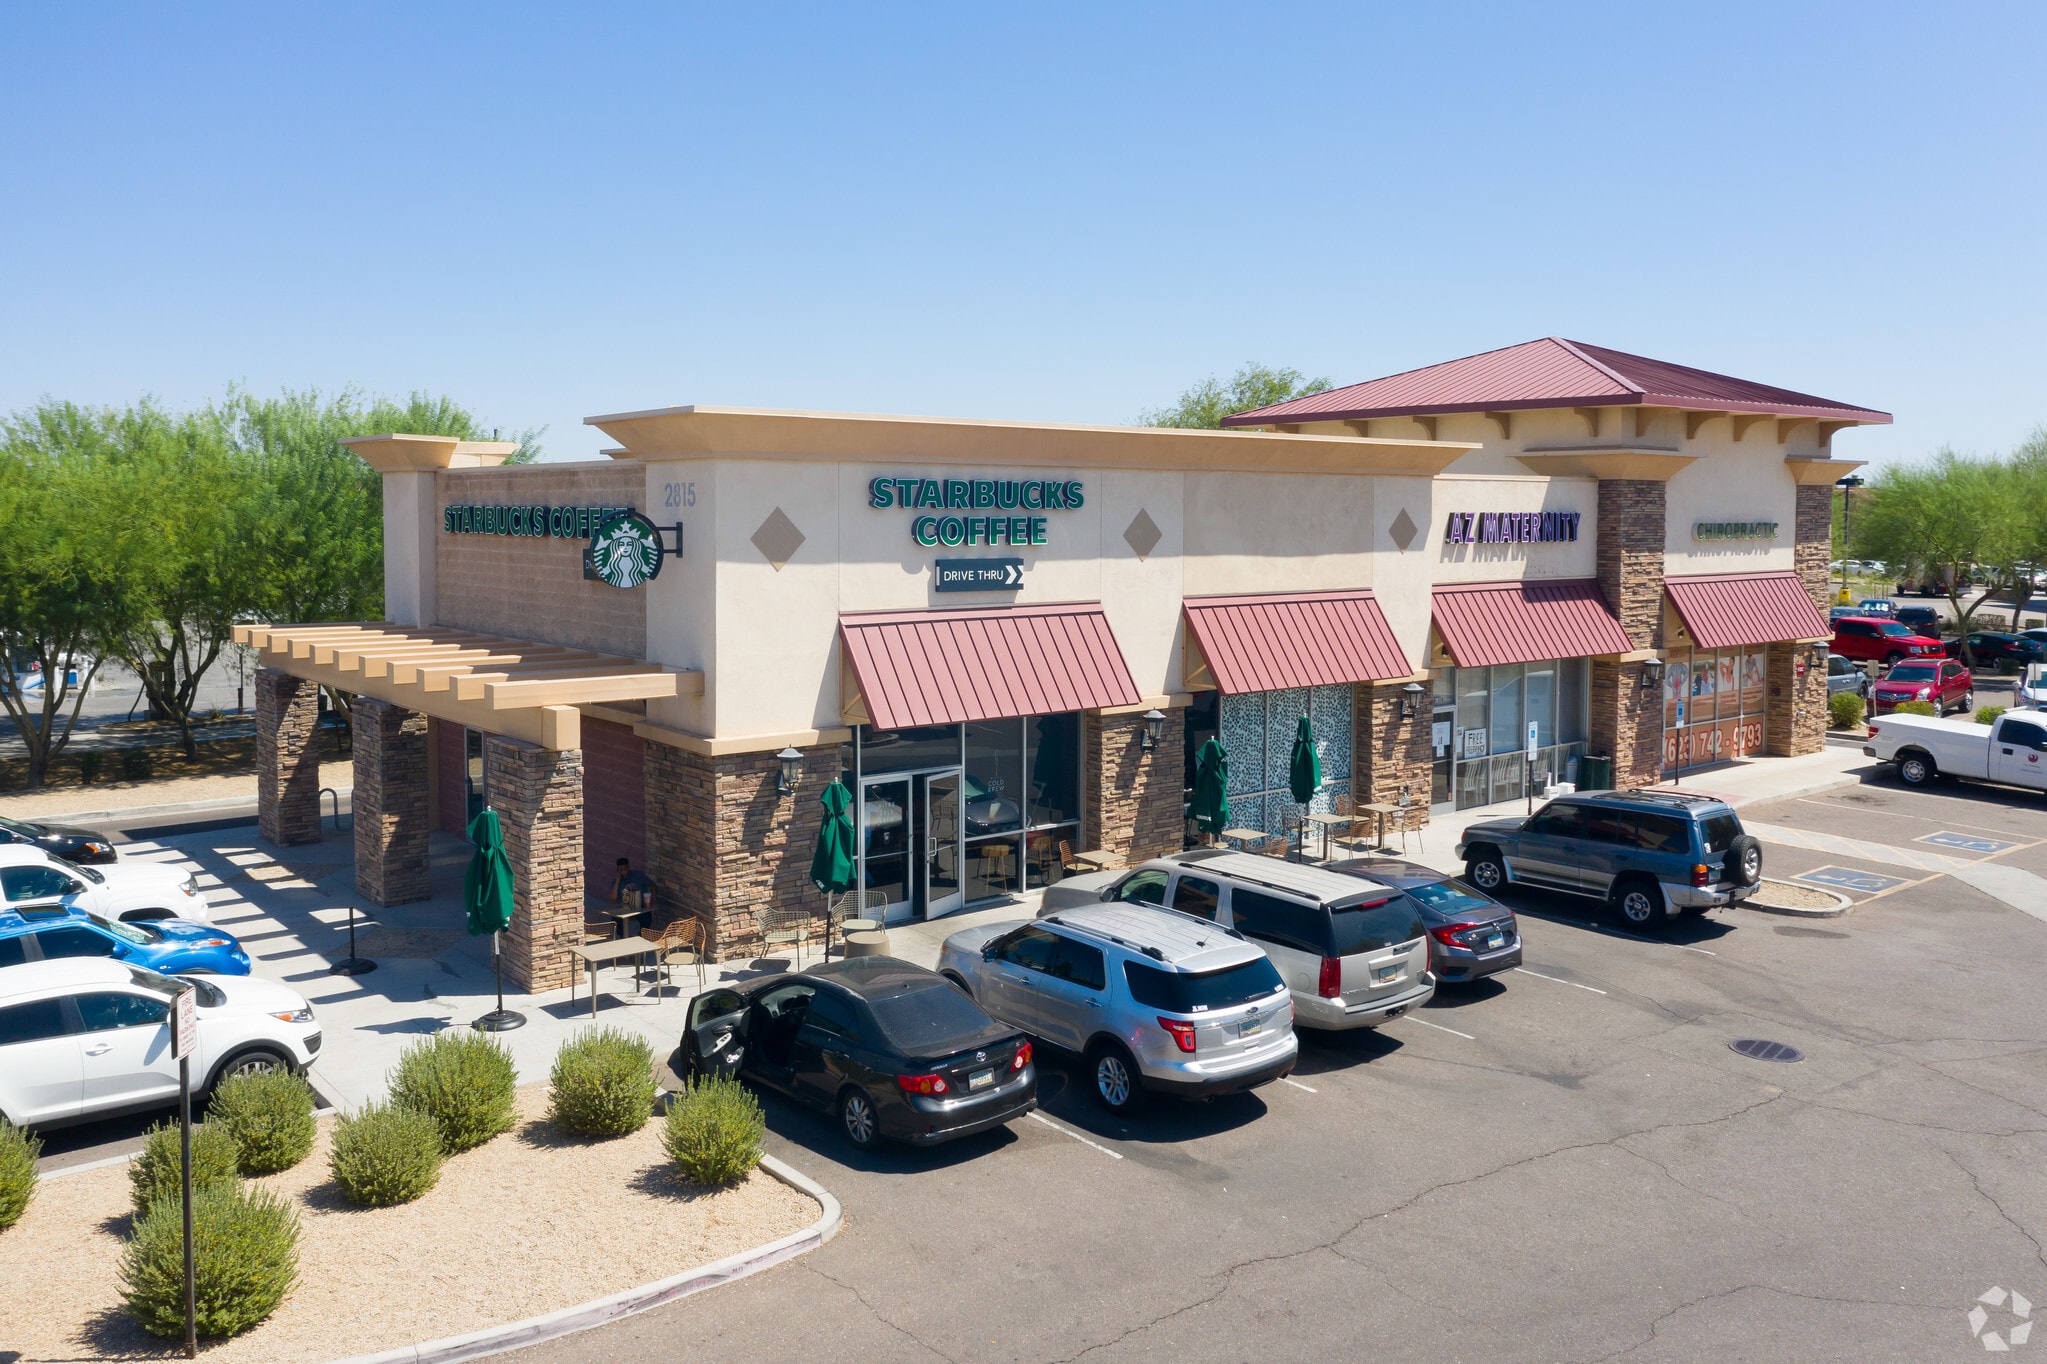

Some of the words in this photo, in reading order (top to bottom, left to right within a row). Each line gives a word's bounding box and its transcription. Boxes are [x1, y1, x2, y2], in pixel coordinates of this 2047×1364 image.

[664, 482, 696, 508] 2815
[870, 477, 1084, 510] STARBUCKS
[443, 505, 546, 538] STARBUCKS
[549, 507, 628, 539] COFF
[912, 516, 1048, 547] COFFEE
[1448, 512, 1475, 544] AZ
[1481, 512, 1580, 543] MATERNITY
[1696, 522, 1779, 540] CHIROPRACTIC
[943, 570, 974, 581] DRIVE
[977, 569, 1004, 581] THRU
[1468, 732, 1483, 745] FREE
[1700, 729, 1723, 757] 742
[1733, 722, 1762, 750] 9793
[987, 779, 1005, 787] COLD
[987, 785, 1004, 793] BREW
